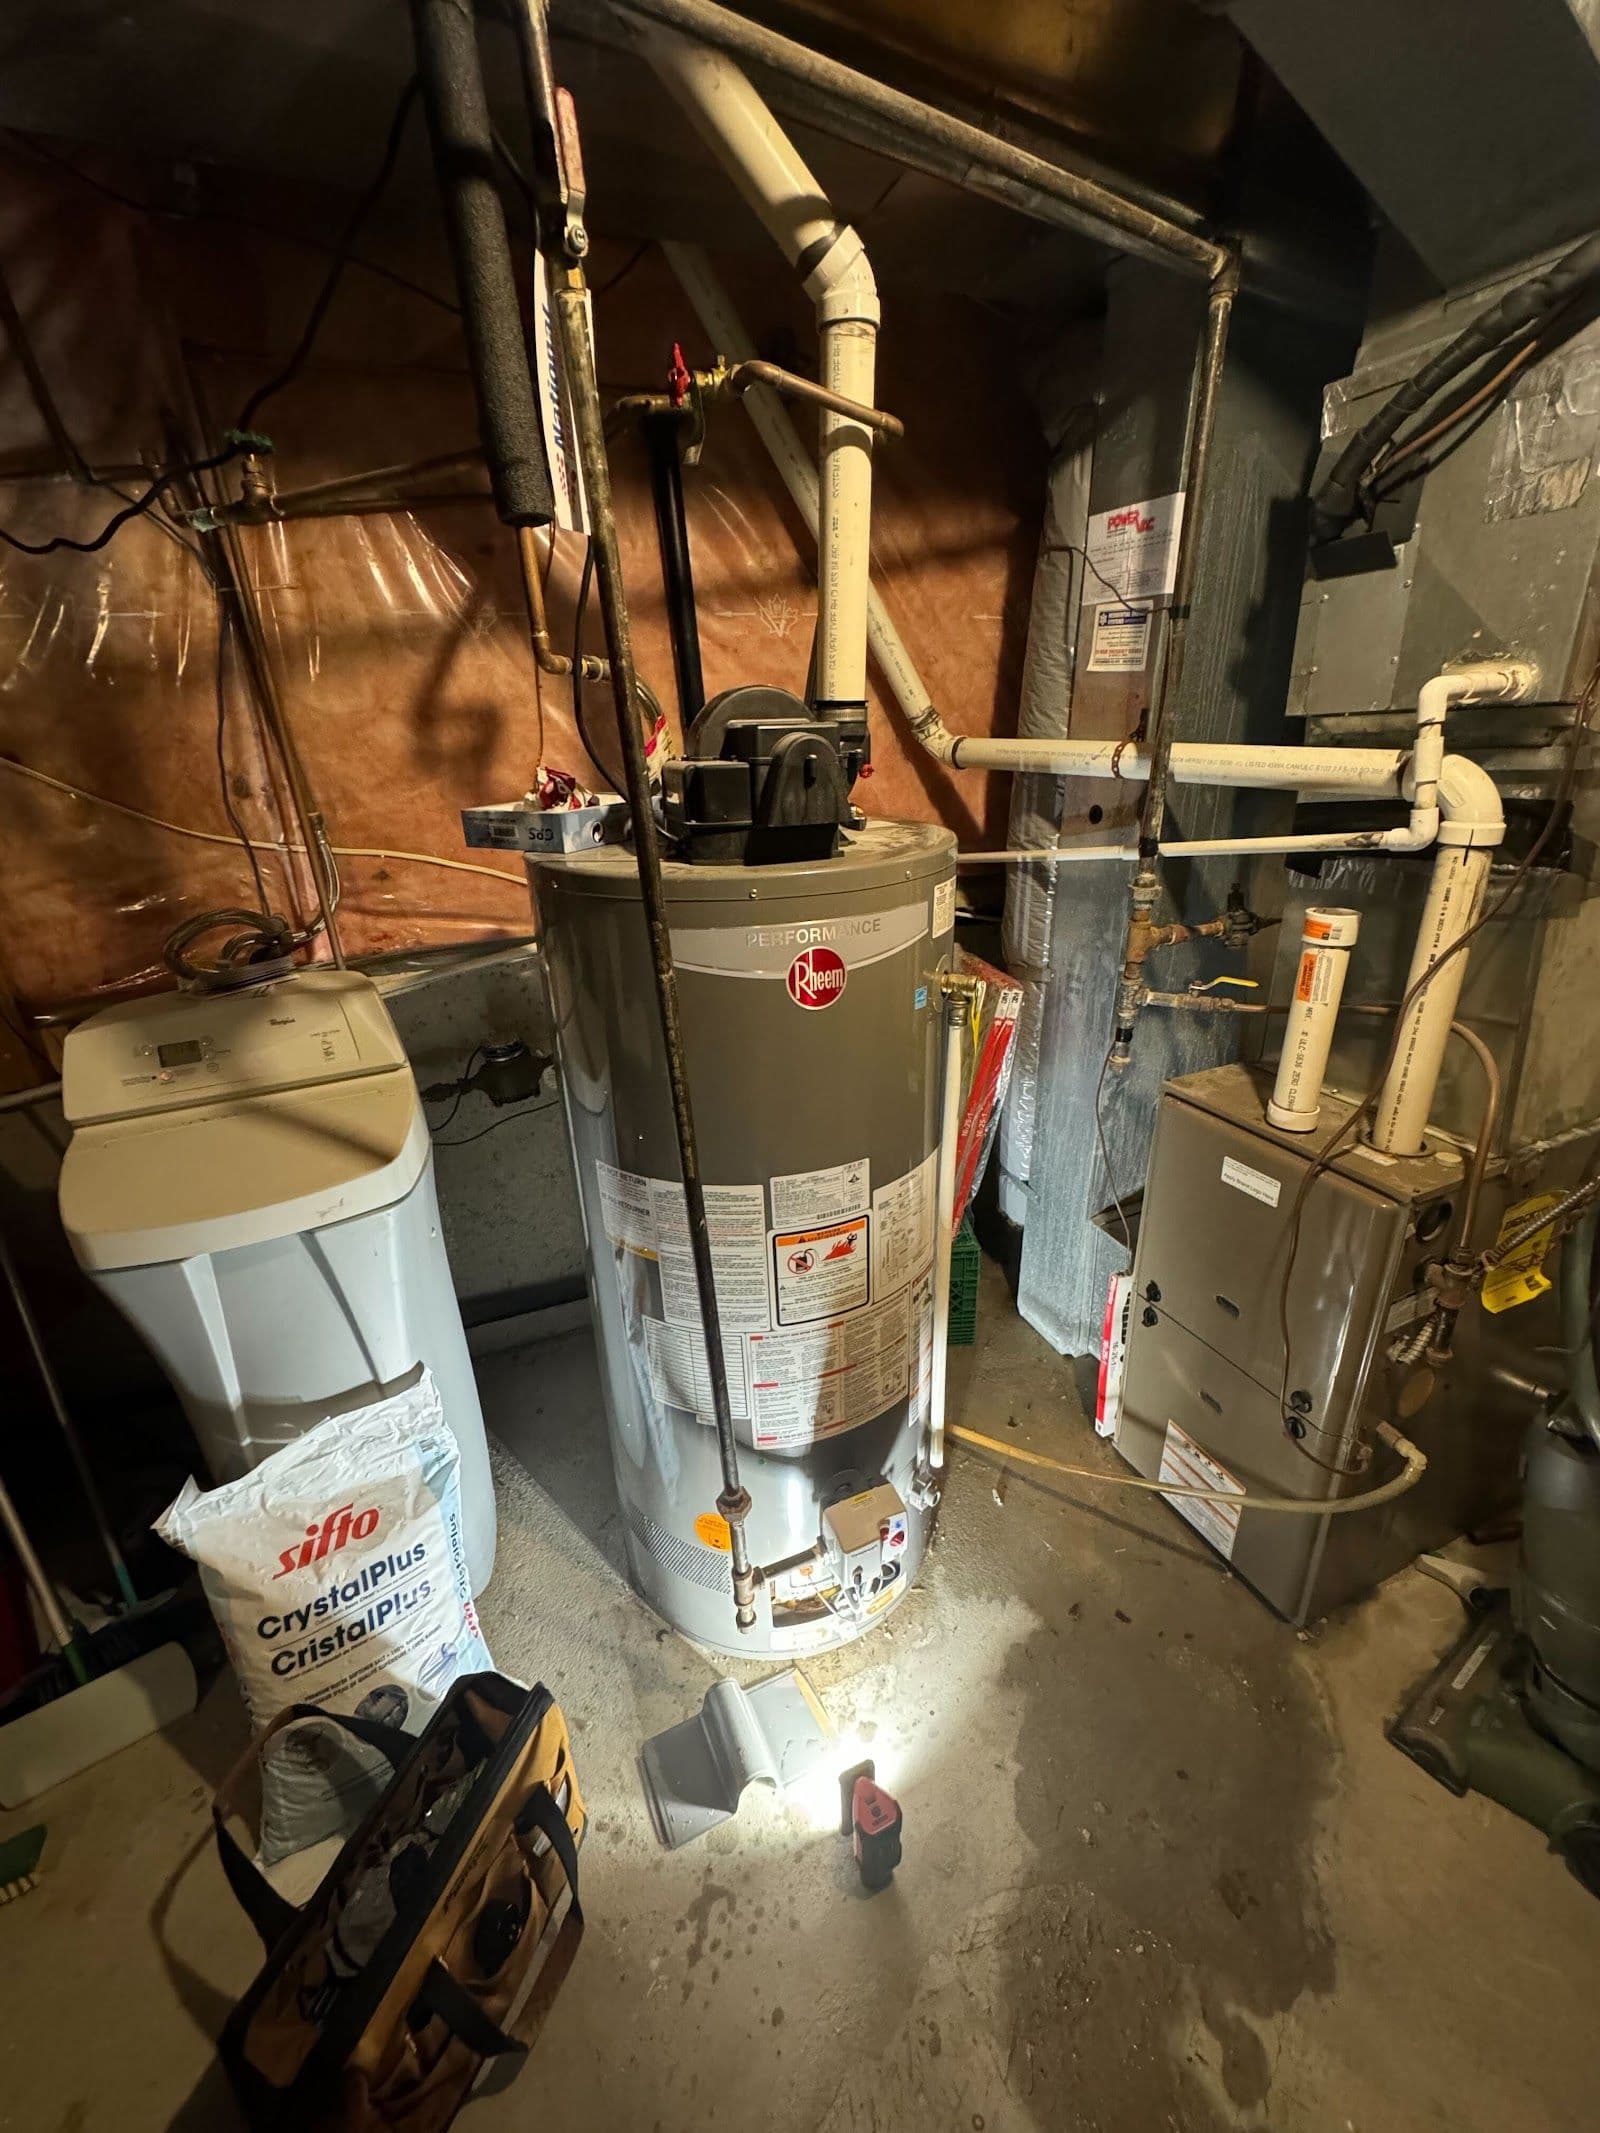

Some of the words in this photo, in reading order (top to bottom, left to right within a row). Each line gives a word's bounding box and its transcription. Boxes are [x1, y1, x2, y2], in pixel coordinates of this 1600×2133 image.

[745, 918, 881, 948] PERFORMANCE
[794, 949, 844, 1000] Rheem
[272, 1503, 380, 1580] sifto
[257, 1543, 427, 1640] CrystalPlus
[271, 1579, 431, 1677] CristalPlus
